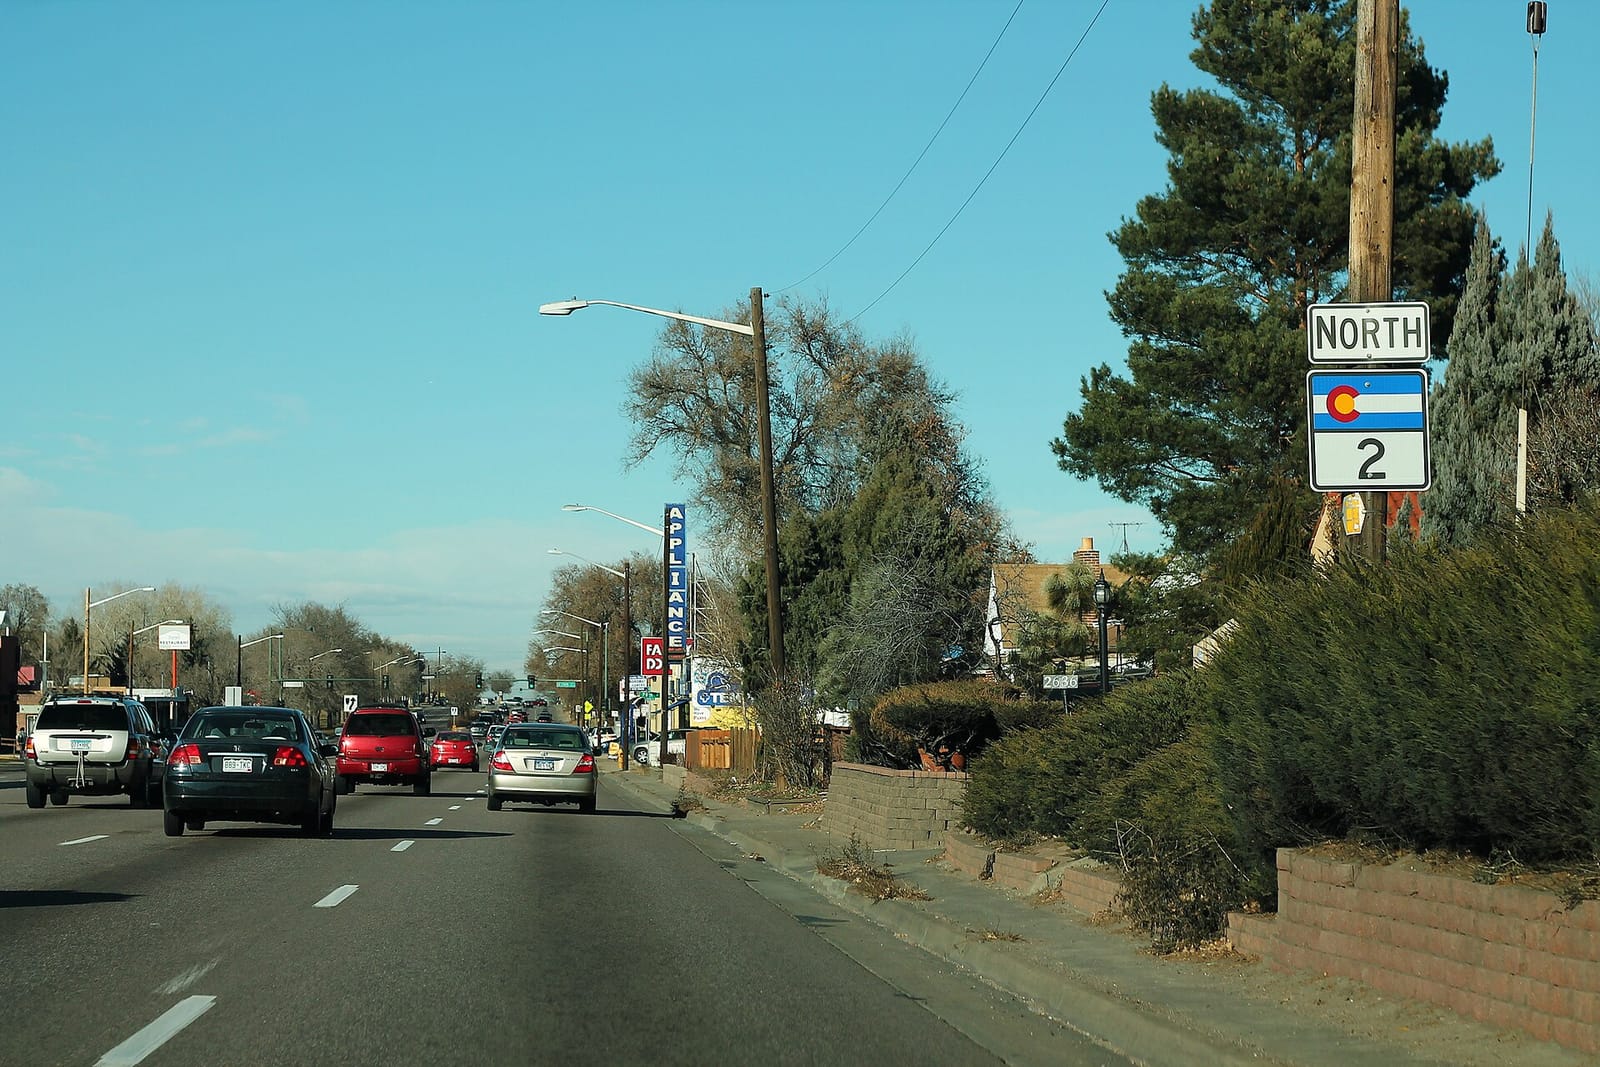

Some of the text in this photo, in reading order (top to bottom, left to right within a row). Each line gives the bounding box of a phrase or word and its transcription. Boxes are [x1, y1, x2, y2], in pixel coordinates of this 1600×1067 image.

[1316, 315, 1422, 350] NORTH
[1357, 437, 1386, 480] 2
[669, 508, 684, 647] APPLIANCE
